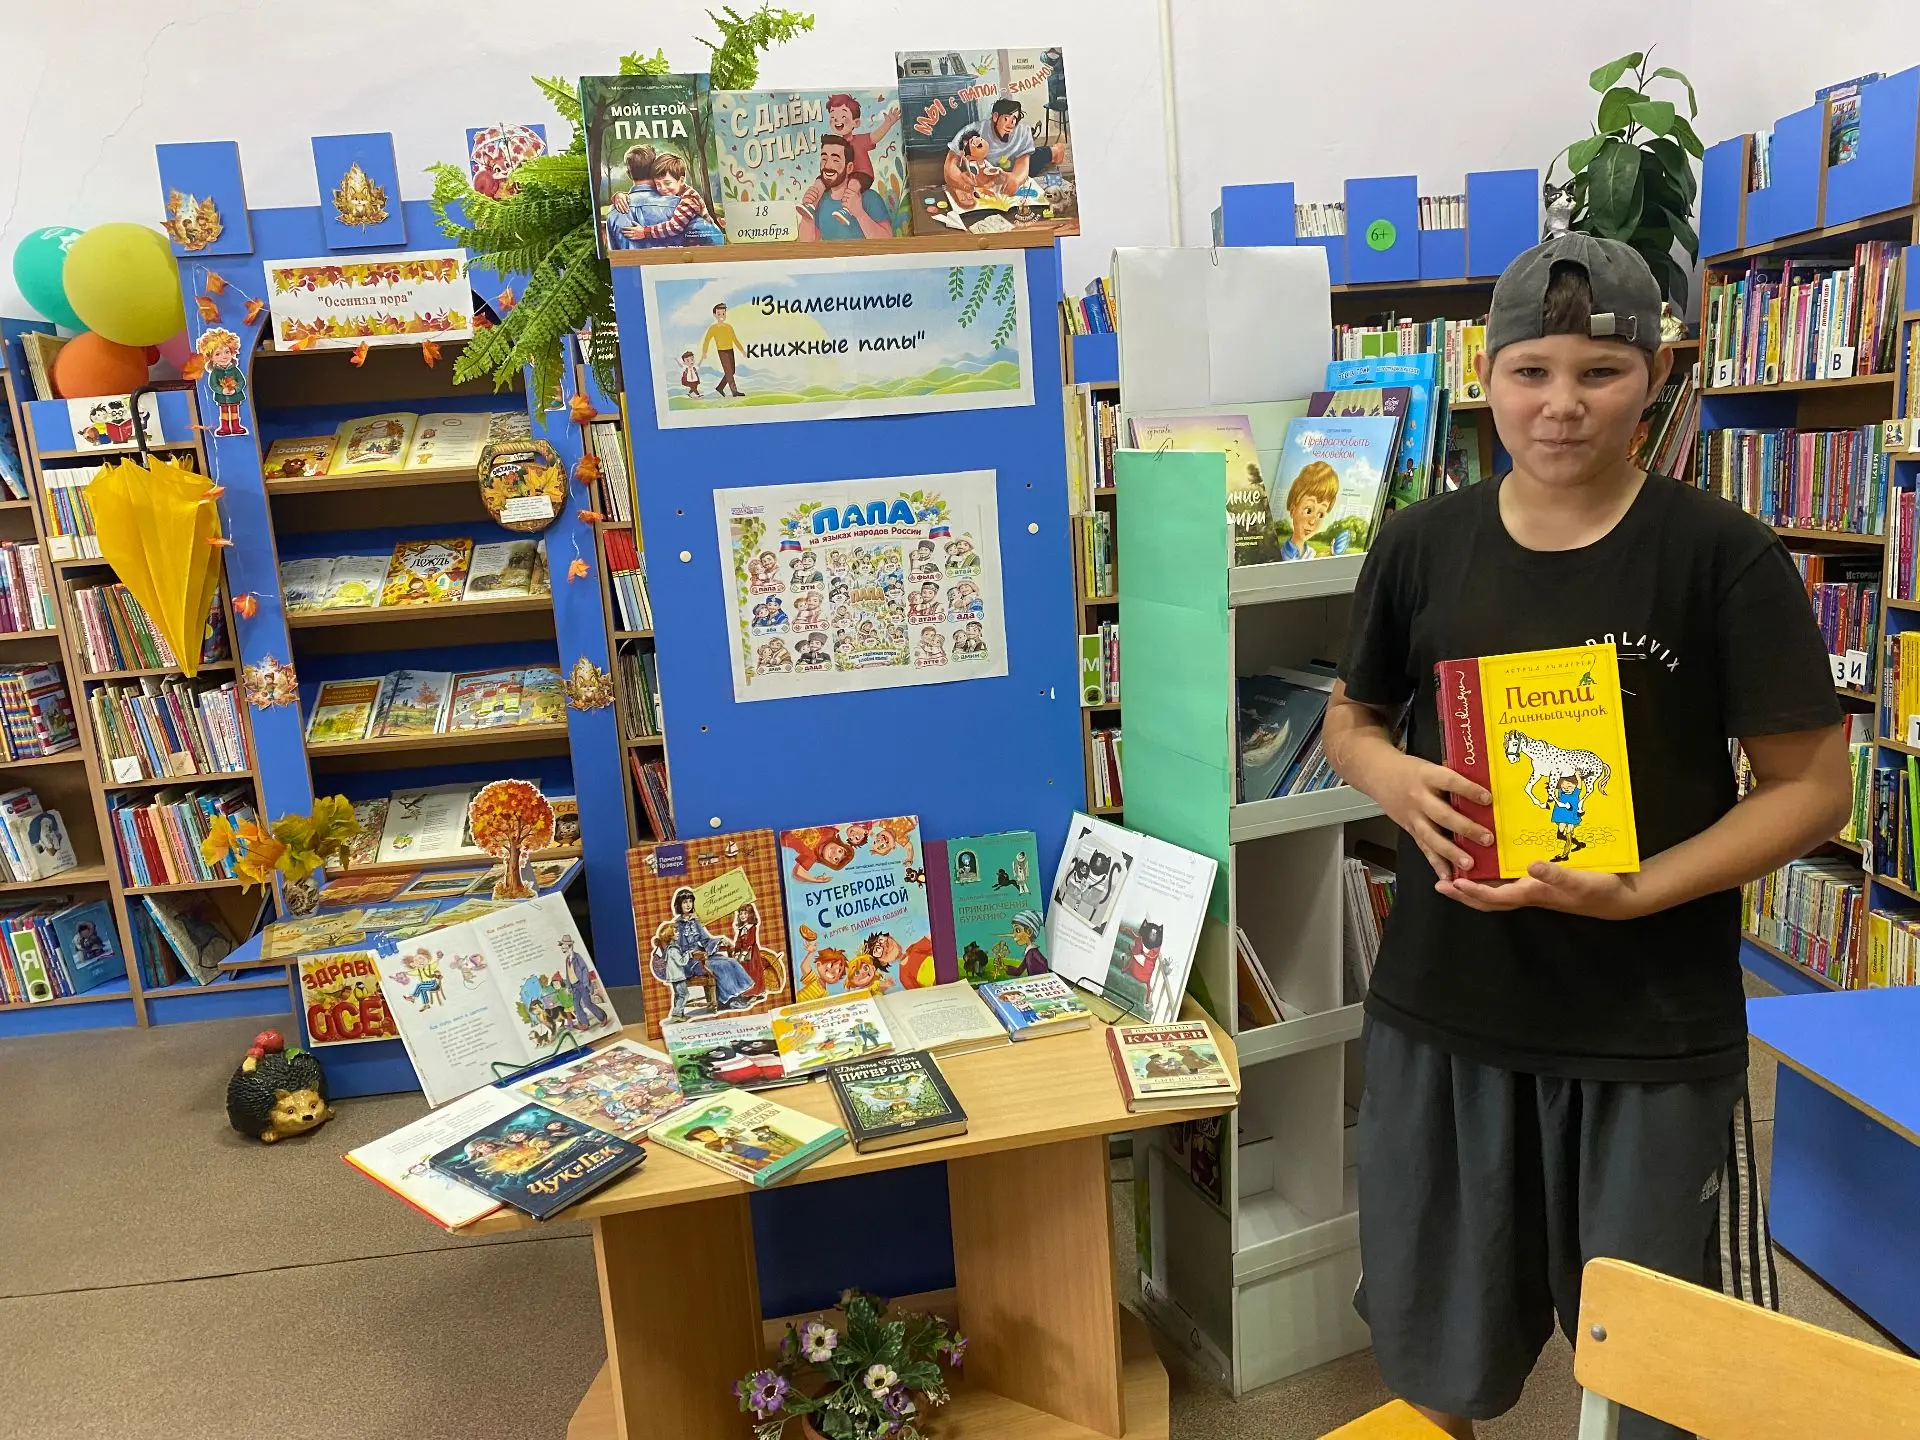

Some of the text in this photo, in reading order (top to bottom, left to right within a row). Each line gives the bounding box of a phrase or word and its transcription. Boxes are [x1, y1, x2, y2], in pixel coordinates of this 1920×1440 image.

[611, 102, 642, 117] МОЙ
[644, 101, 687, 116] ГЕРОЙ
[730, 94, 823, 138] С ДНЁМ
[914, 99, 946, 136] МЫ
[614, 119, 688, 140] ПАПА
[743, 127, 818, 169] ОТЦА!
[755, 205, 769, 217] 18
[737, 224, 790, 240] октября
[1370, 227, 1389, 241] 6+
[317, 291, 413, 309] "Осенняя пора"
[751, 291, 914, 316] "Знаменитые
[746, 330, 926, 359] книжные папы"
[1832, 354, 1842, 371] В
[1719, 365, 1727, 380] Б
[492, 464, 519, 476] ОКТЯБРЬ
[811, 499, 916, 535] ПАПА
[822, 531, 851, 543] языках
[854, 528, 889, 538] народов
[891, 526, 922, 536] России
[1083, 657, 1100, 673] М
[1851, 661, 1862, 680] И
[1505, 686, 1595, 710] Пеппи
[1498, 704, 1608, 724] Длинныйчулок
[658, 861, 684, 869] Траверс
[805, 872, 895, 907] БУТЕРБРОДЫ
[818, 886, 909, 928] С КОЛБАСОЙ
[958, 900, 1028, 915] ПРИКЛЮЧЕНИЯ
[850, 915, 881, 932] ПАПИНЫ
[959, 912, 1007, 924] БУРАТИНО
[302, 960, 375, 989] ЗДРАВ
[1126, 1030, 1204, 1044] КАТАЕВ
[839, 1060, 923, 1083] ПИТЕР ПЭН
